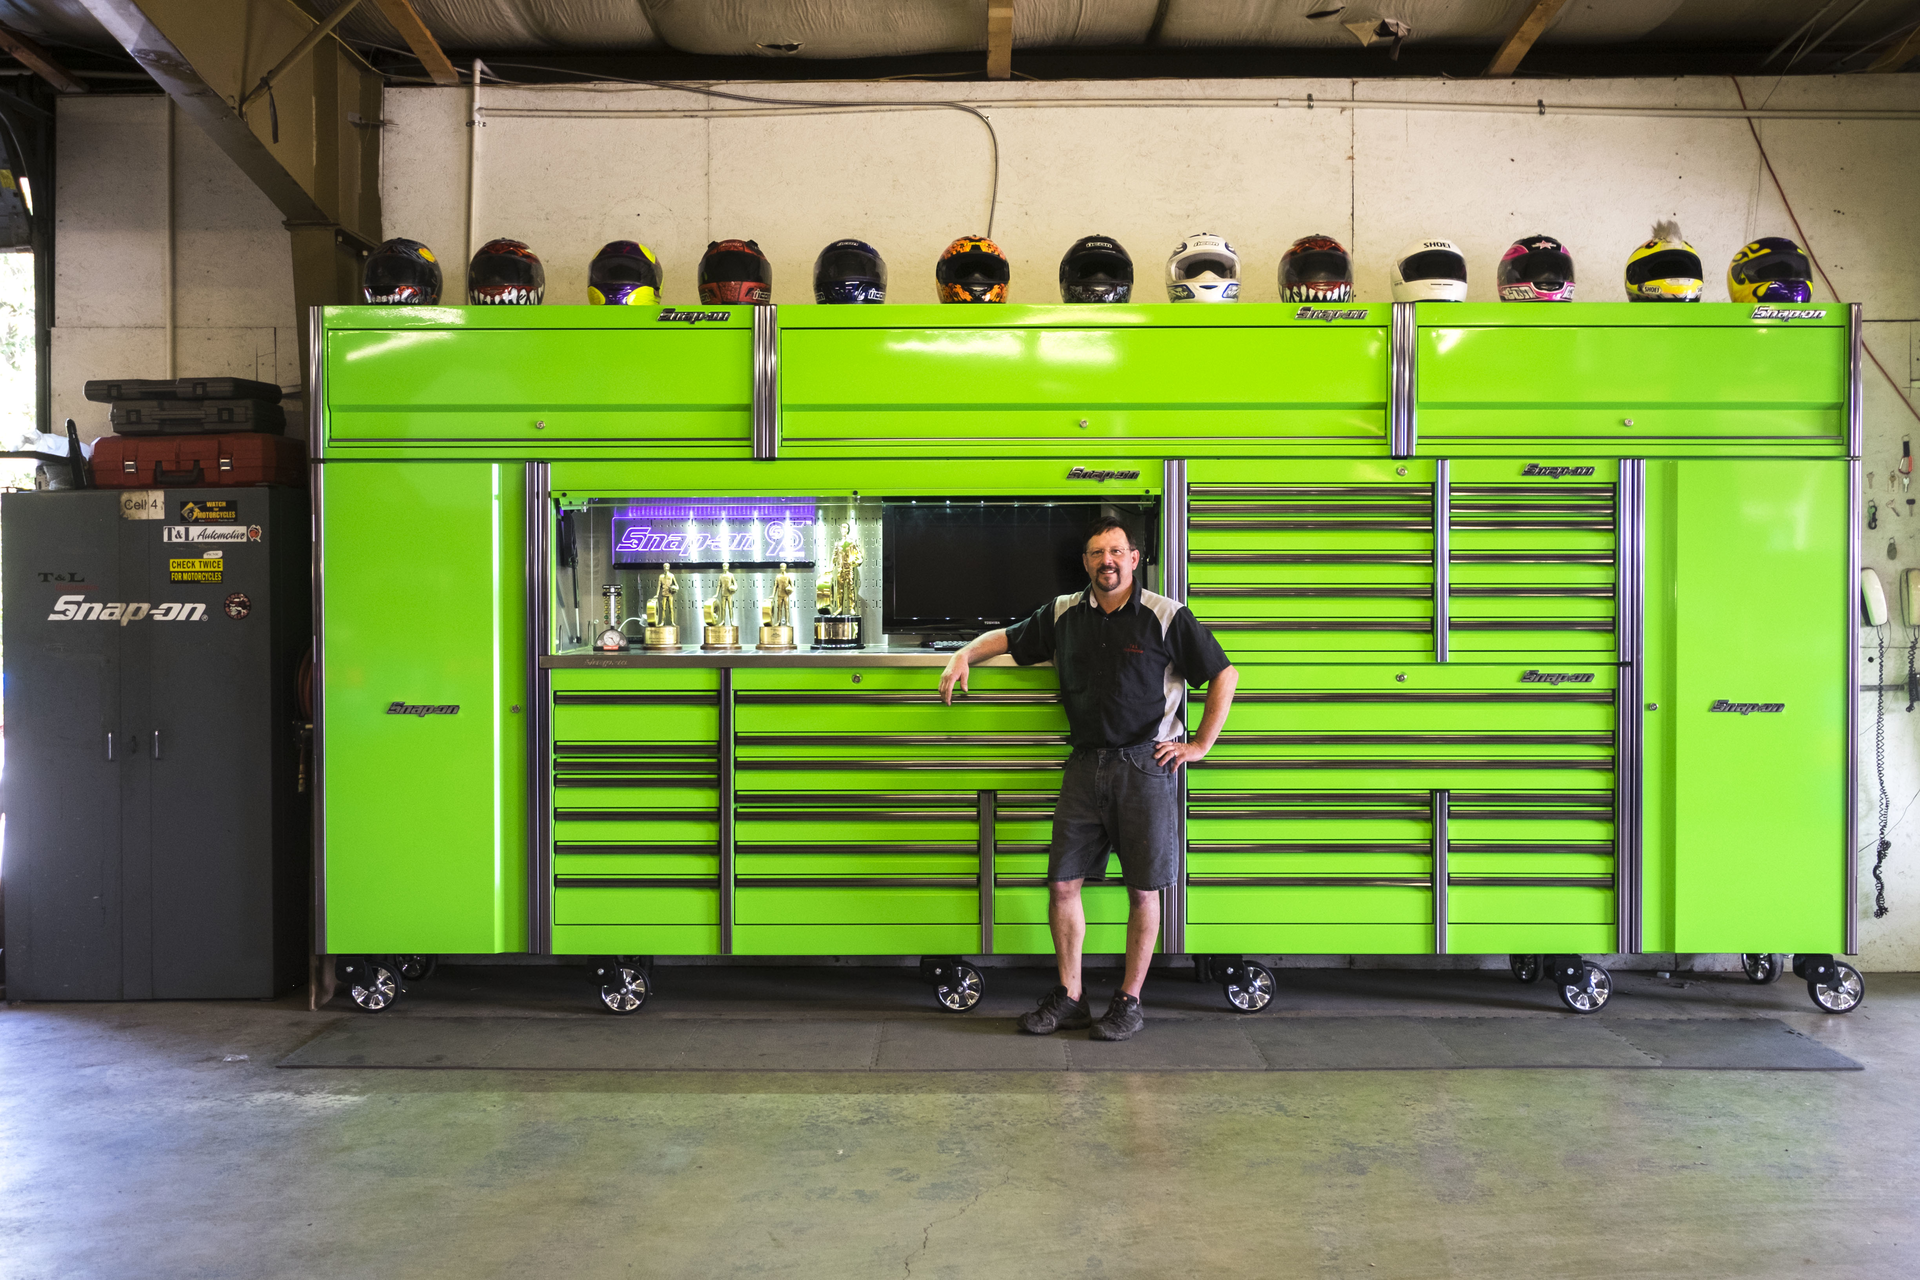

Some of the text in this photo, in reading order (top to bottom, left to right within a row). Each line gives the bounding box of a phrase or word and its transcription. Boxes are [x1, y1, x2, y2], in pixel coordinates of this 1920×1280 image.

[1423, 241, 1451, 249] SHOEI
[1644, 286, 1660, 294] SHOEI
[657, 308, 731, 325] Snap-on
[1294, 306, 1369, 323] Snap-on
[1751, 305, 1827, 322] Snap-on
[1066, 466, 1140, 483] Snap-on
[1521, 463, 1595, 479] Snap-on
[124, 499, 158, 510] Cell 4
[197, 511, 236, 519] MOTORCYCLES
[197, 527, 246, 541] Automotive
[616, 526, 754, 556] Snap-on
[171, 560, 222, 569] CHECK TWICE
[171, 572, 183, 581] FOR
[182, 572, 222, 581] MOTORCYCLES
[47, 594, 207, 627] Snap-on
[1520, 669, 1595, 685] Snap-on
[386, 700, 461, 717] Snap-on
[1709, 699, 1785, 716] Snap-on
